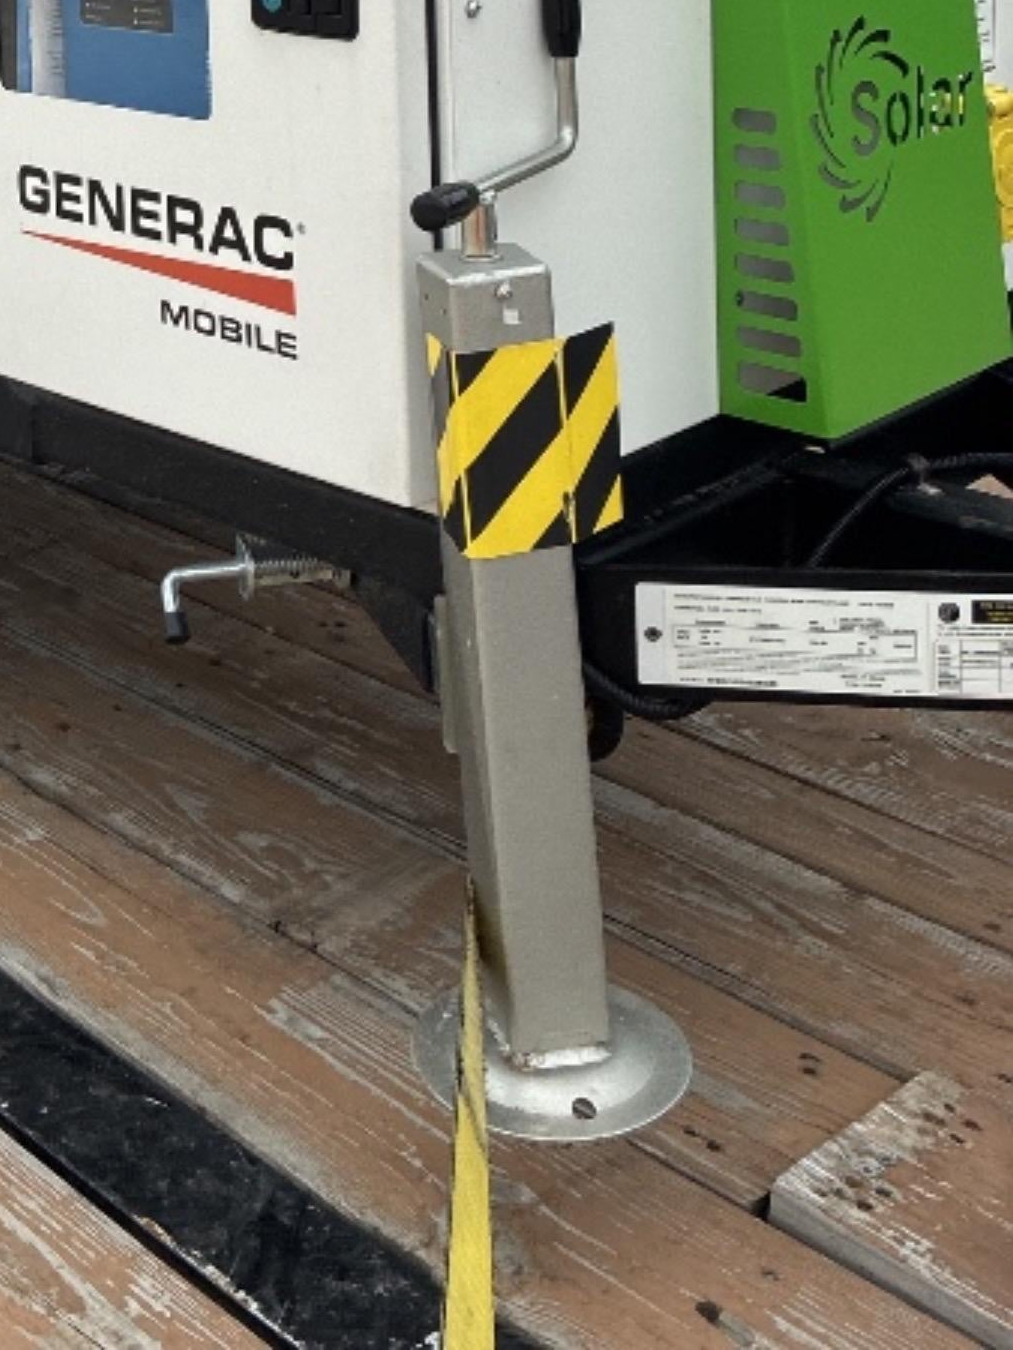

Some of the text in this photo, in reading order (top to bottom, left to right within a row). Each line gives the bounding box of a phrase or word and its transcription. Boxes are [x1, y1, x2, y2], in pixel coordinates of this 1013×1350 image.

[850, 64, 974, 157] Solar
[17, 164, 295, 271] GENERAC
[159, 298, 298, 361] MOBILE
